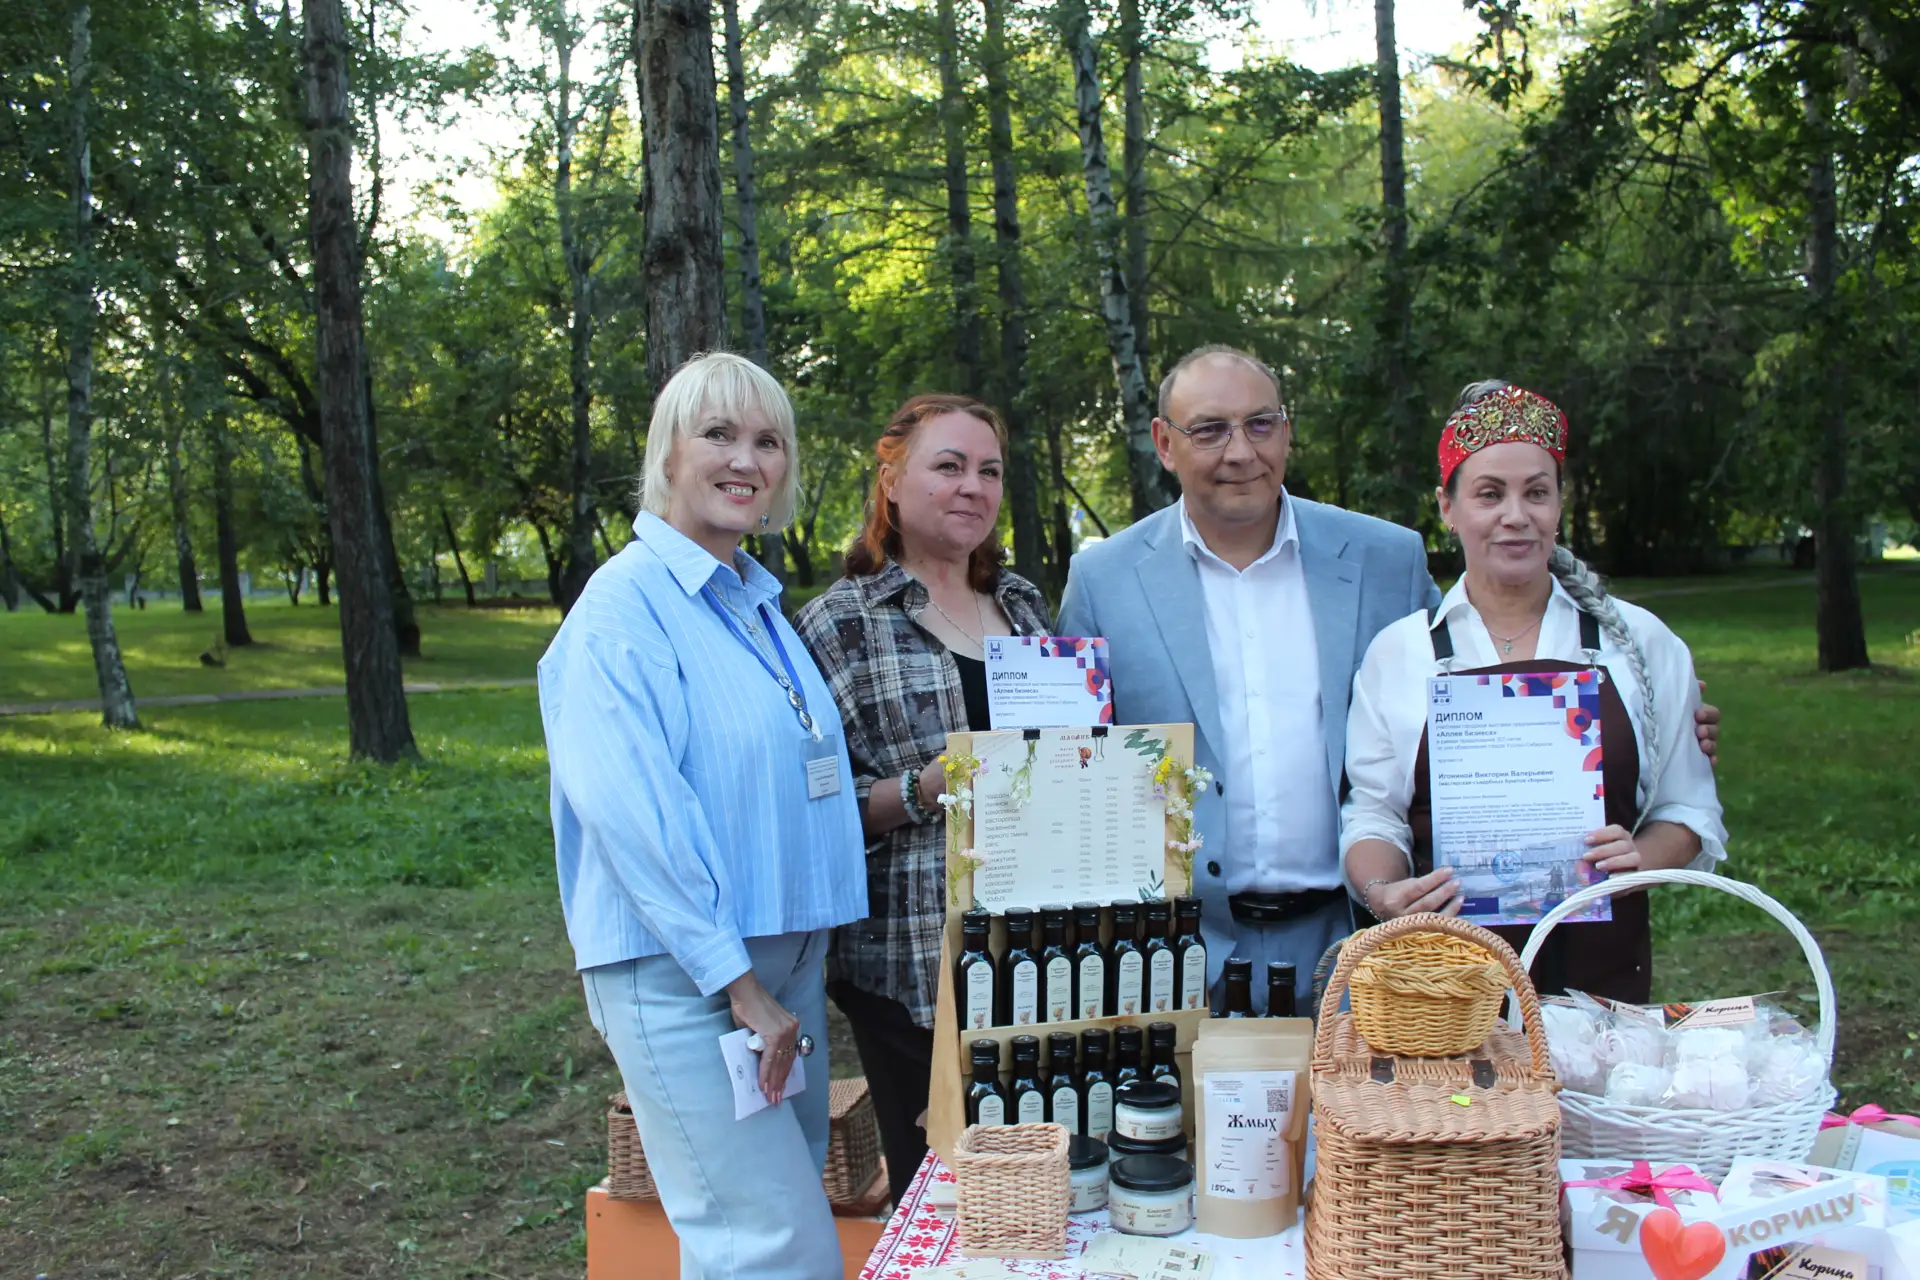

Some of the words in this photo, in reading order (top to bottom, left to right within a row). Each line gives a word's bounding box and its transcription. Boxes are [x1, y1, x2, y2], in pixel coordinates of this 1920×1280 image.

[992, 672, 1028, 681] ДИПЛОМ
[1435, 712, 1483, 724] ДИПЛОМ
[1475, 771, 1509, 779] Виктории
[1511, 770, 1554, 778] Валерьевне
[1705, 1004, 1750, 1014] Корица
[1595, 1204, 1640, 1245] Я
[1727, 1192, 1857, 1248] КОРИЦУ
[1799, 1257, 1854, 1280] Корица
